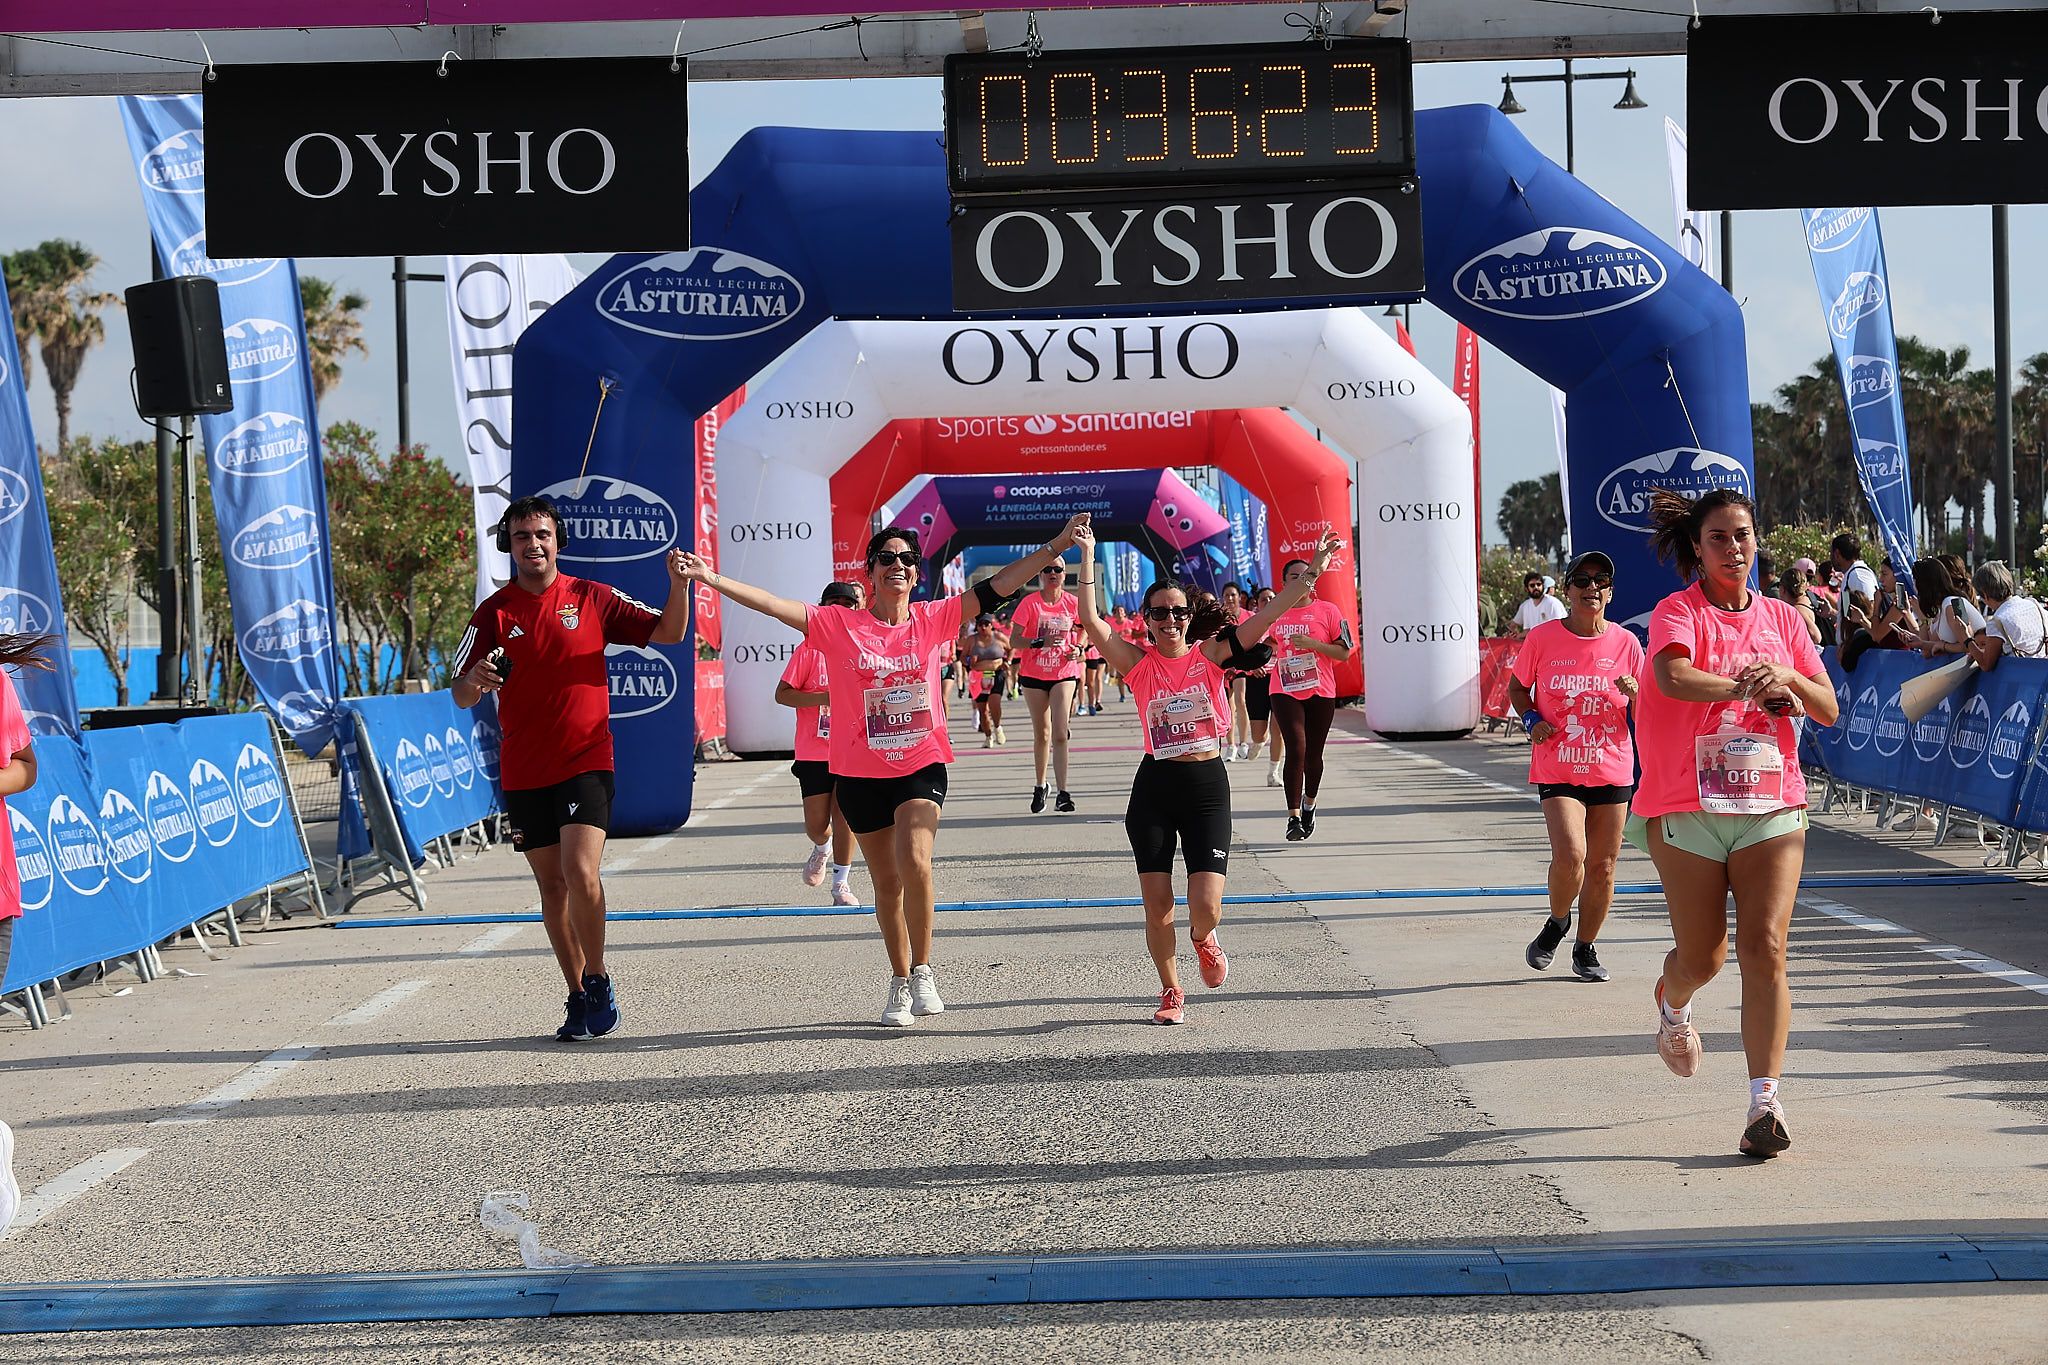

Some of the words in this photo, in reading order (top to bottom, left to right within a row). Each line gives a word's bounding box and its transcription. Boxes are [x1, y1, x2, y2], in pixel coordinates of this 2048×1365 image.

[980, 62, 1378, 167] 00:36:23
[1768, 77, 2048, 144] OYSH
[284, 128, 616, 198] OYSHO
[975, 196, 1398, 293] OYSHO
[1500, 258, 1570, 274] CENTRAL
[1576, 252, 1642, 265] LECHERA
[644, 277, 711, 288] CENTRAL
[718, 279, 786, 291] LECHERA
[1471, 263, 1655, 301] ASTURIANA
[608, 280, 788, 317] ASTURIANA
[942, 322, 1239, 385] OYSHO
[1327, 378, 1416, 401] OYSHO
[766, 400, 854, 420] OYSHO
[937, 416, 1020, 443] Sports
[1061, 409, 1196, 434] Santander
[1020, 442, 1107, 456] sportssantander.es
[1632, 477, 1691, 488] CENTRAL
[1697, 473, 1742, 485] LECHERA
[1010, 485, 1062, 498] octopus
[1062, 484, 1106, 498] energy
[557, 505, 604, 514] ENTRAL
[609, 505, 664, 516] LECHERA
[986, 504, 998, 512] LA
[1000, 502, 1042, 512] ENERGÍA
[1044, 503, 1070, 511] PARA
[1072, 501, 1111, 510] CORRER
[1379, 501, 1461, 523] OYSHO
[1009, 513, 1064, 521] VELOCIDAD
[563, 517, 669, 542] TURIANA
[731, 521, 812, 543] OYSHO
[1382, 622, 1464, 644] OYSHO
[734, 643, 796, 664] OYSH
[858, 653, 921, 670] CARRERA
[1550, 659, 1576, 667] OYSHO
[609, 662, 663, 672] LECHERA
[1550, 675, 1610, 692] CARRERA
[1582, 696, 1602, 716] DE
[888, 712, 912, 725] 016
[1171, 721, 1196, 734] 016
[885, 751, 904, 761] 2026
[1557, 745, 1604, 764] MUJER
[1573, 765, 1590, 774] 2026
[1727, 769, 1760, 784] 016
[1710, 801, 1738, 809] OYSHO
